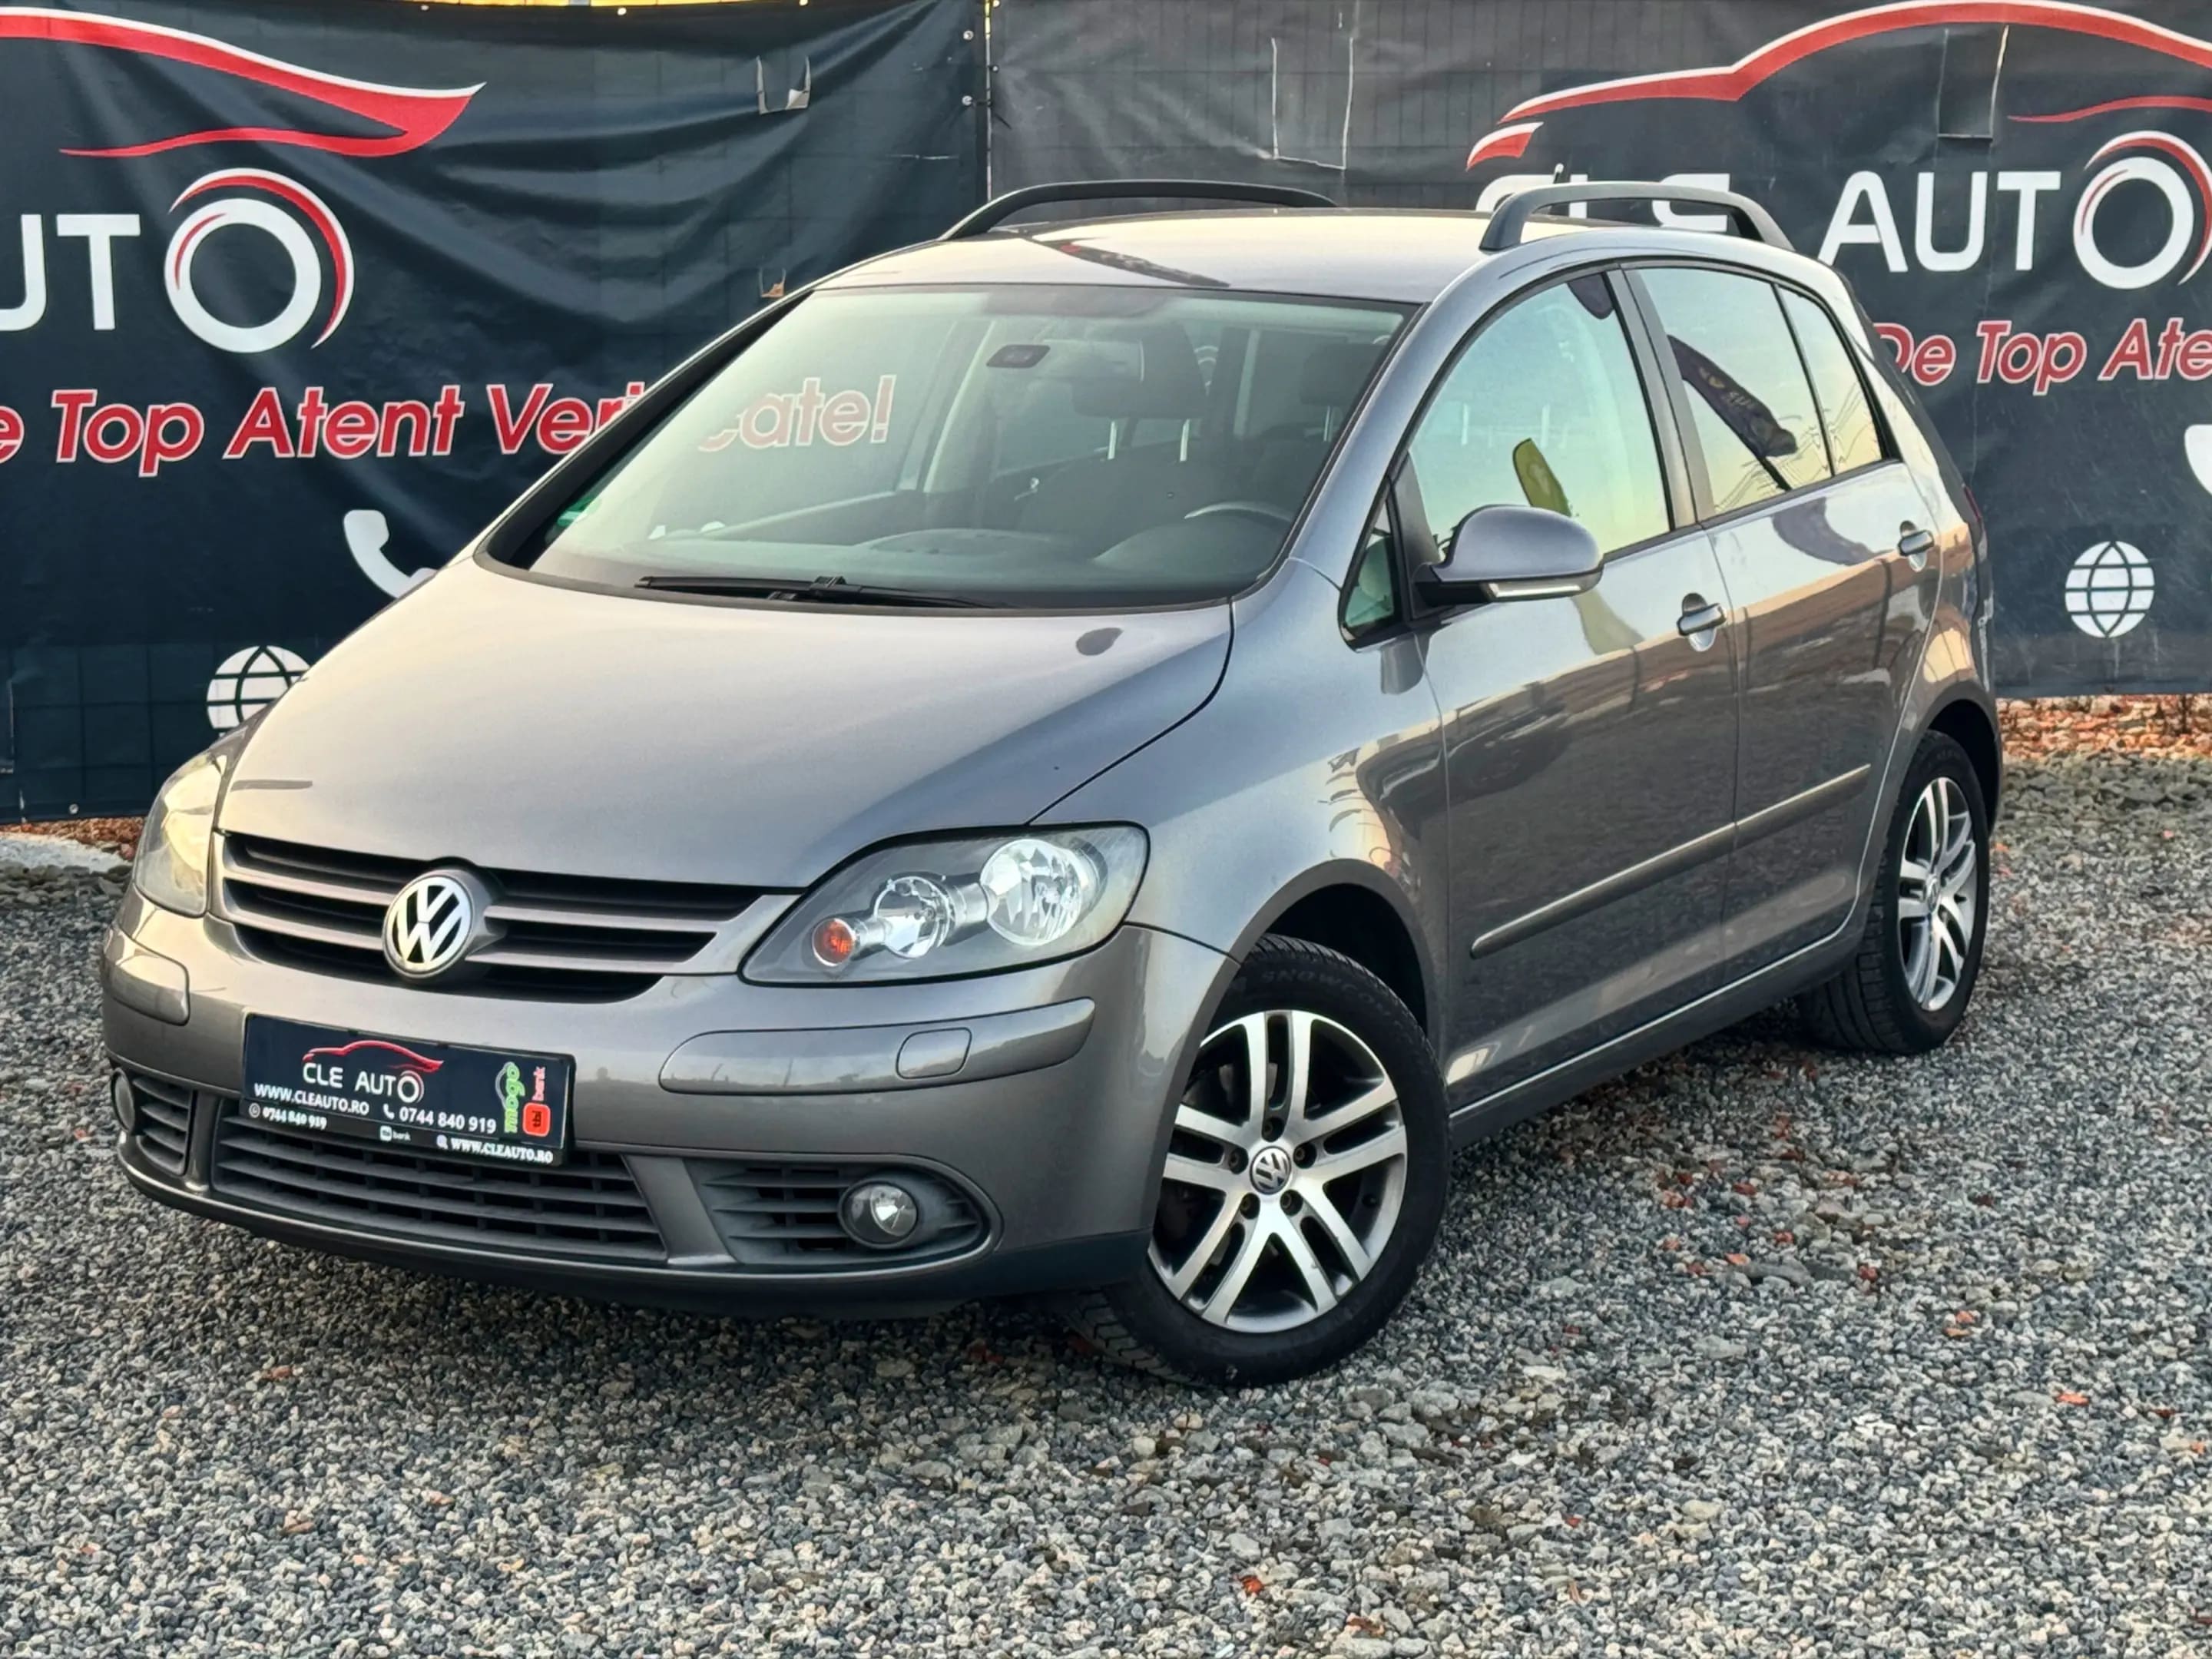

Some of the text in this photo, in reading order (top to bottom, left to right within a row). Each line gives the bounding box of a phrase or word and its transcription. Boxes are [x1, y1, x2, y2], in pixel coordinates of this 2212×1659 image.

[1817, 156, 2194, 290] AUTO
[1976, 320, 2088, 396] Top
[51, 389, 205, 477] Top
[223, 386, 465, 459] Atent
[253, 1082, 369, 1115] WWW.CLEAUTO.RO
[302, 1062, 423, 1103] CLE AUTO
[263, 1107, 286, 1123] 0744
[308, 1116, 327, 1130] 919
[399, 1106, 496, 1134] 0744 840 919
[450, 1137, 554, 1164] WWW.CLEAUTO.RO
